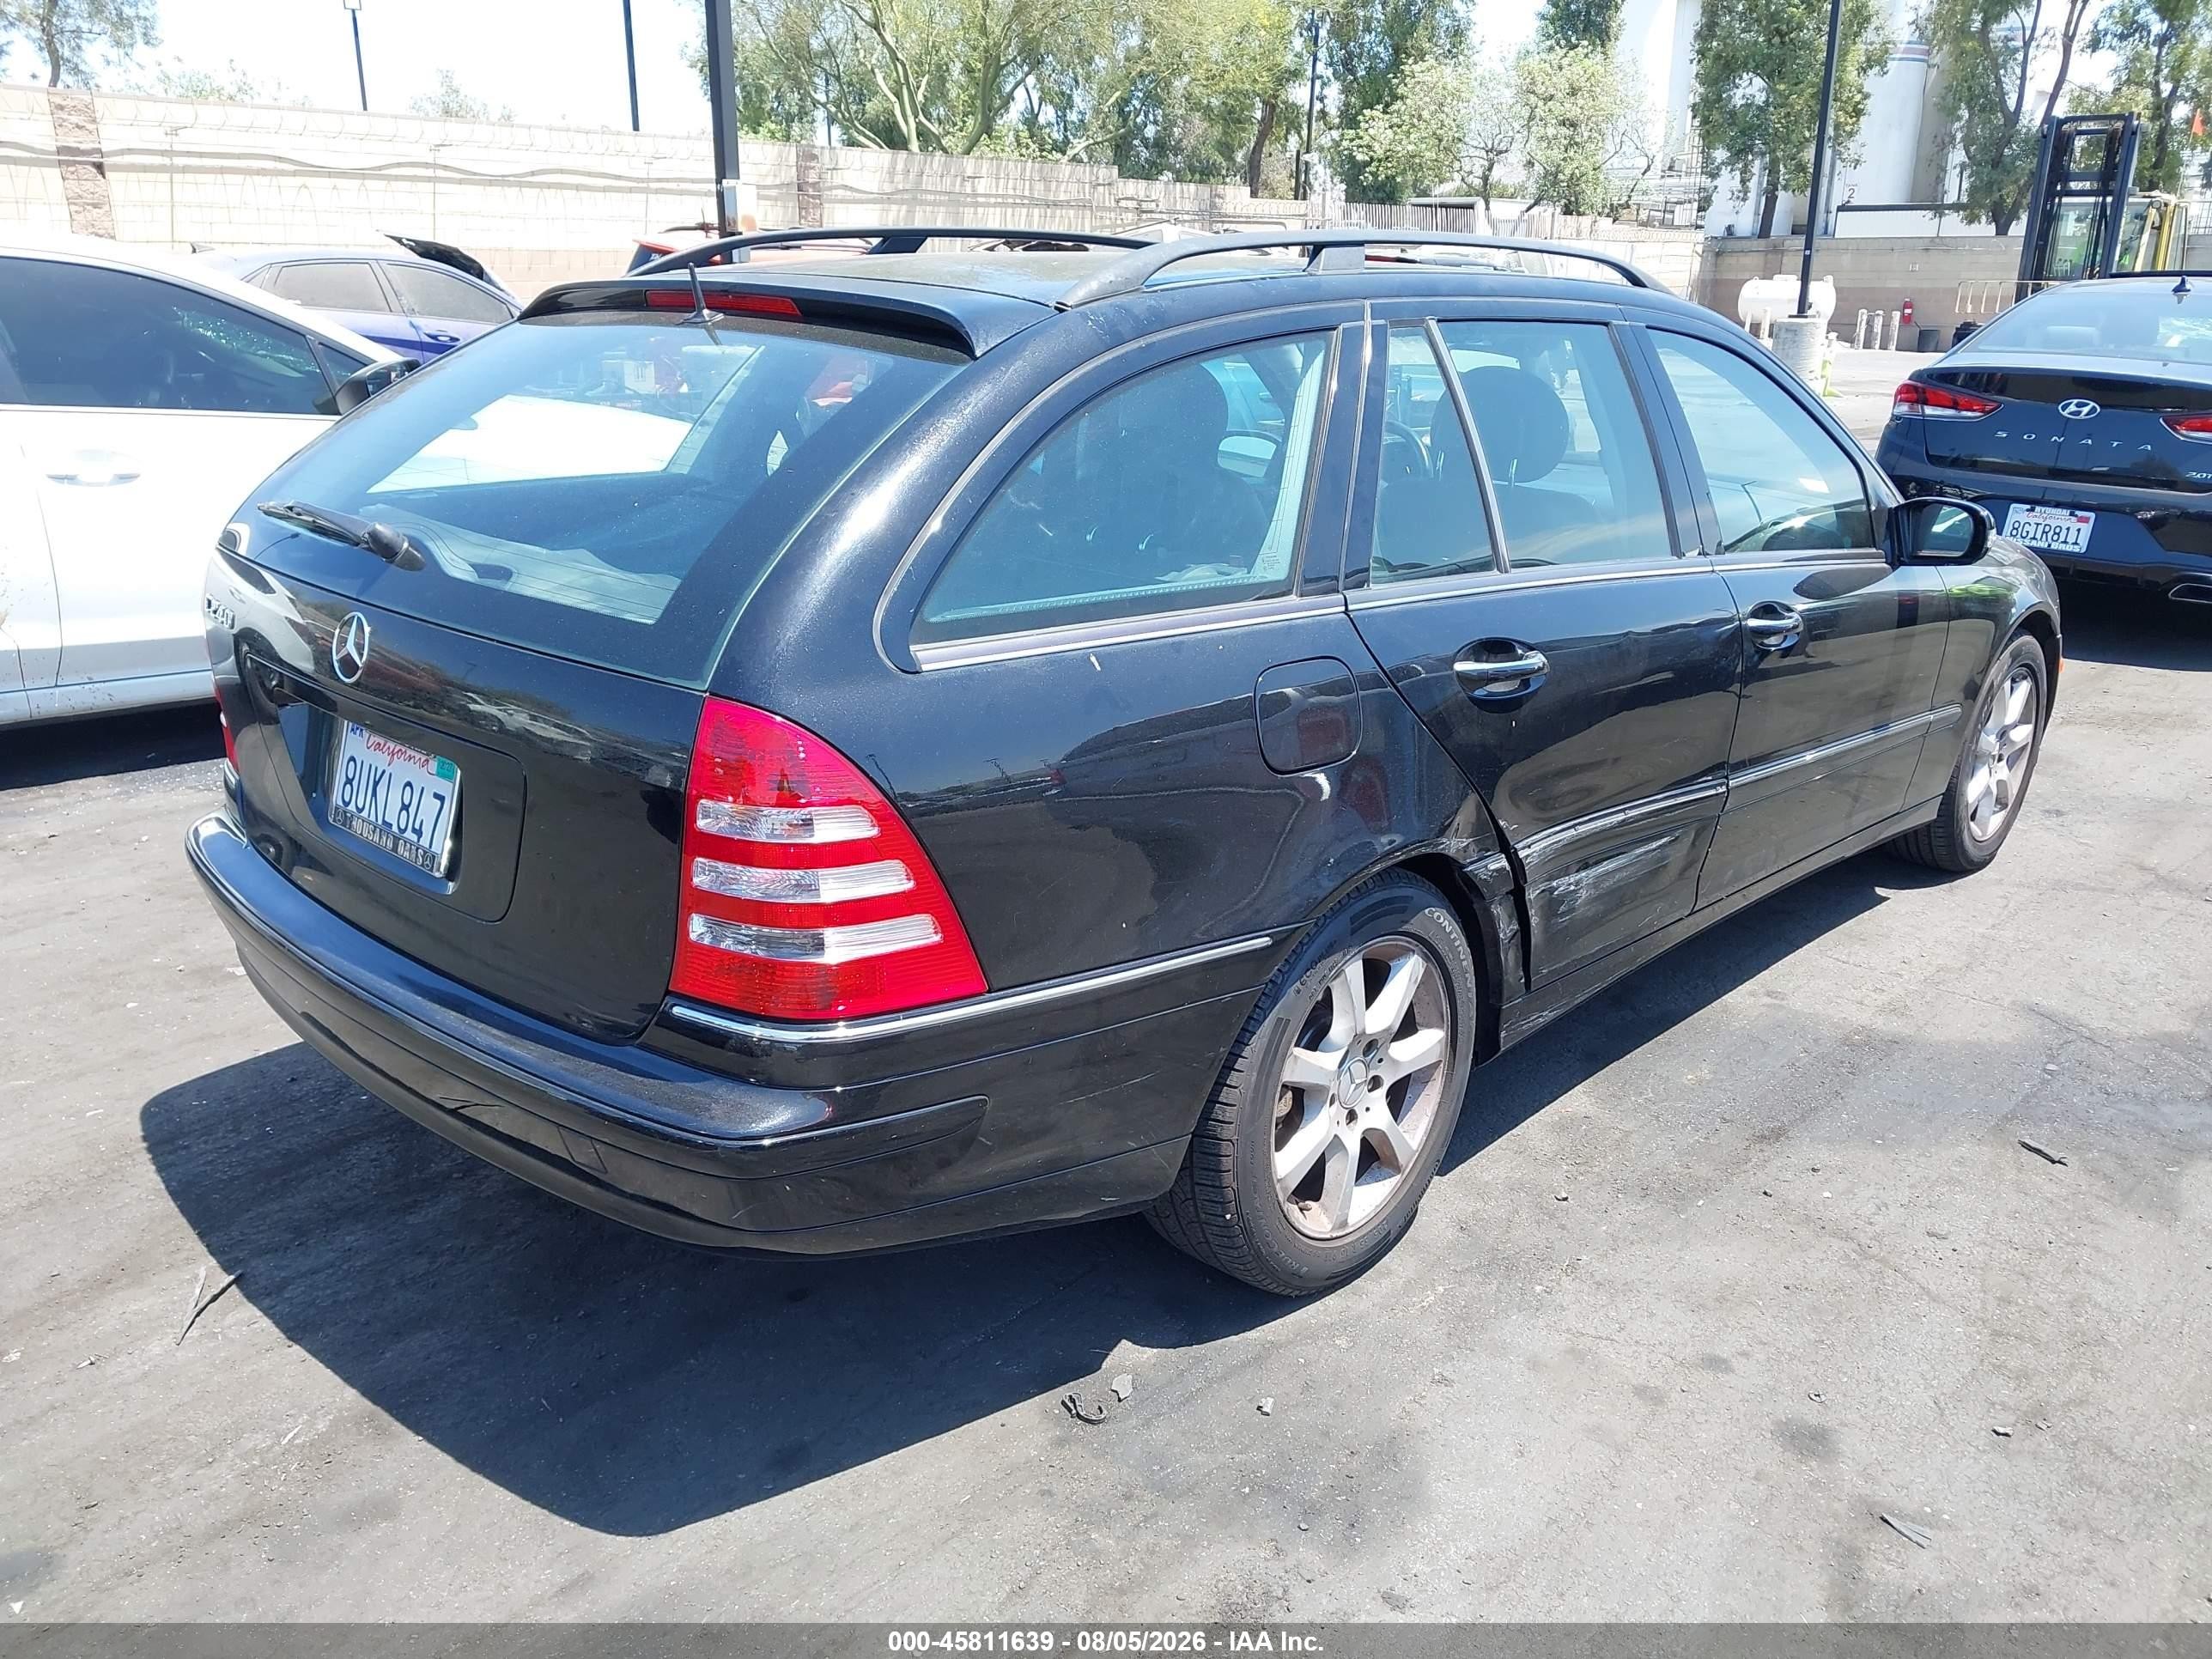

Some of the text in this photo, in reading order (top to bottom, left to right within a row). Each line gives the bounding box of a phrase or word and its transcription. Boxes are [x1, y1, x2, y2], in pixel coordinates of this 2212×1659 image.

[1848, 187, 1855, 198] 2
[1994, 430, 2152, 451] SONATA
[2027, 511, 2075, 522] California
[2034, 506, 2070, 516] HYUNDAI
[2010, 520, 2082, 545] 8GIR811
[2050, 541, 2081, 552] BROS
[366, 732, 434, 775] California
[341, 755, 446, 849] 8UKL847
[346, 812, 424, 866] THOUSAND OAKS
